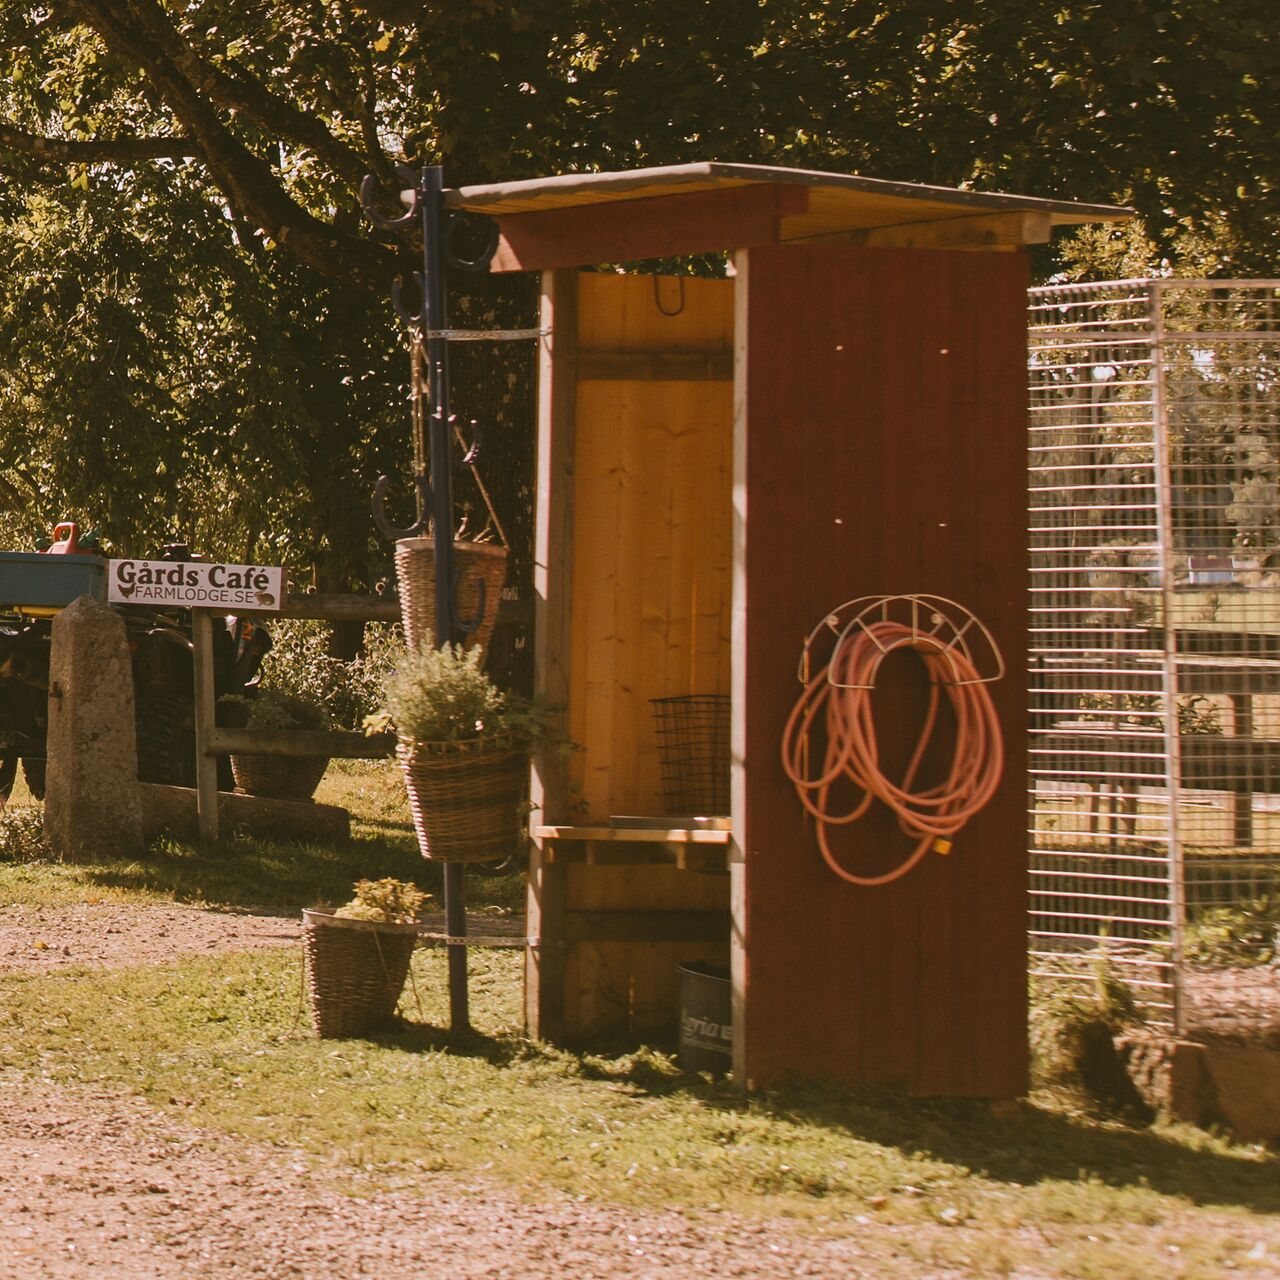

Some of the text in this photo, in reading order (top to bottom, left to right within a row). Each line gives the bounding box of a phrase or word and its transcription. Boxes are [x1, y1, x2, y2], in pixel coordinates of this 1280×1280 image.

[117, 561, 270, 590] Gårds Café
[135, 586, 254, 604] FARMLODGE.SE
